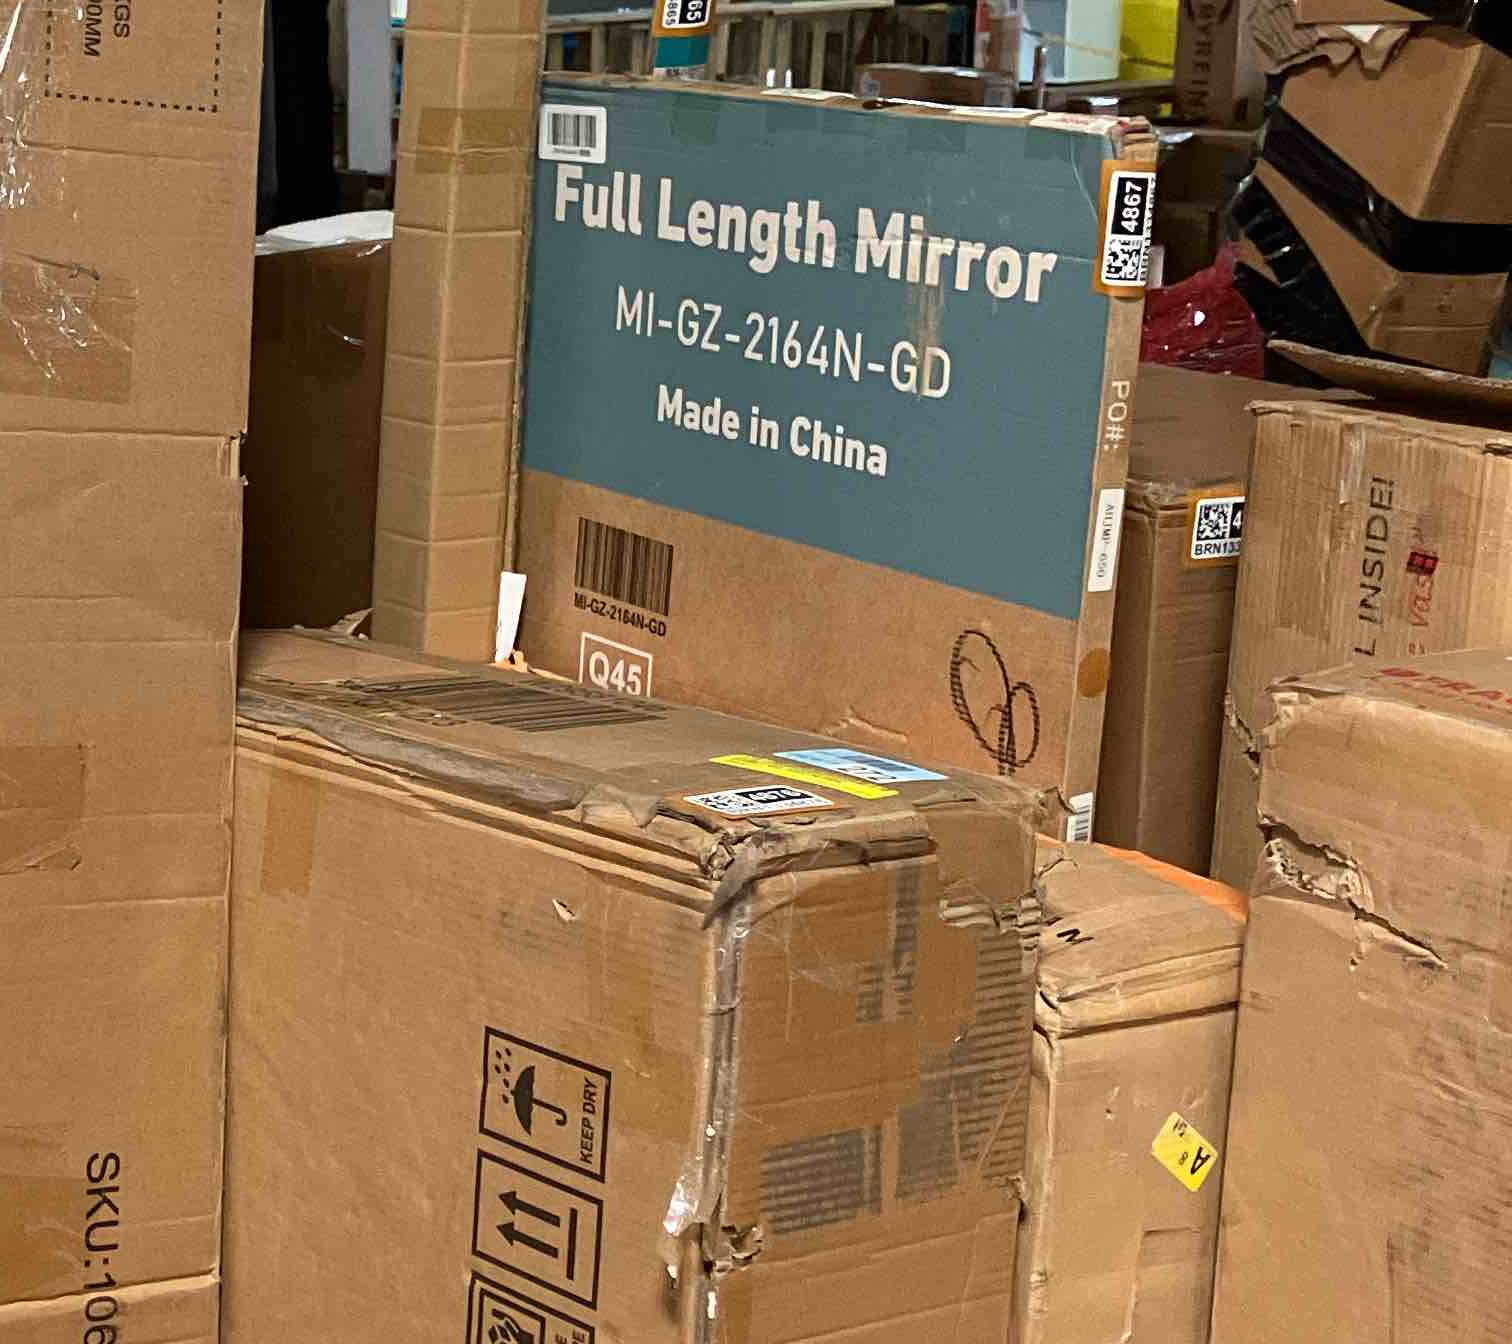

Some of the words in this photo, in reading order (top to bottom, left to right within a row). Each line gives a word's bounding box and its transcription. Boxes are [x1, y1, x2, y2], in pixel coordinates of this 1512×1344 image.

[554, 162, 643, 236] Full
[656, 176, 837, 274] Length
[854, 206, 1059, 303] Mirror
[1120, 180, 1143, 234] 4867
[615, 284, 952, 400] MI-GZ-2164N-GD
[656, 383, 740, 441] Made
[749, 405, 780, 451] in
[789, 415, 889, 478] China
[1102, 379, 1131, 452] PO#:
[573, 591, 667, 637] MI-GZ-2164N-GD
[589, 650, 643, 696] Q45
[584, 1077, 600, 1113] DRY
[579, 1116, 596, 1165] KEEP
